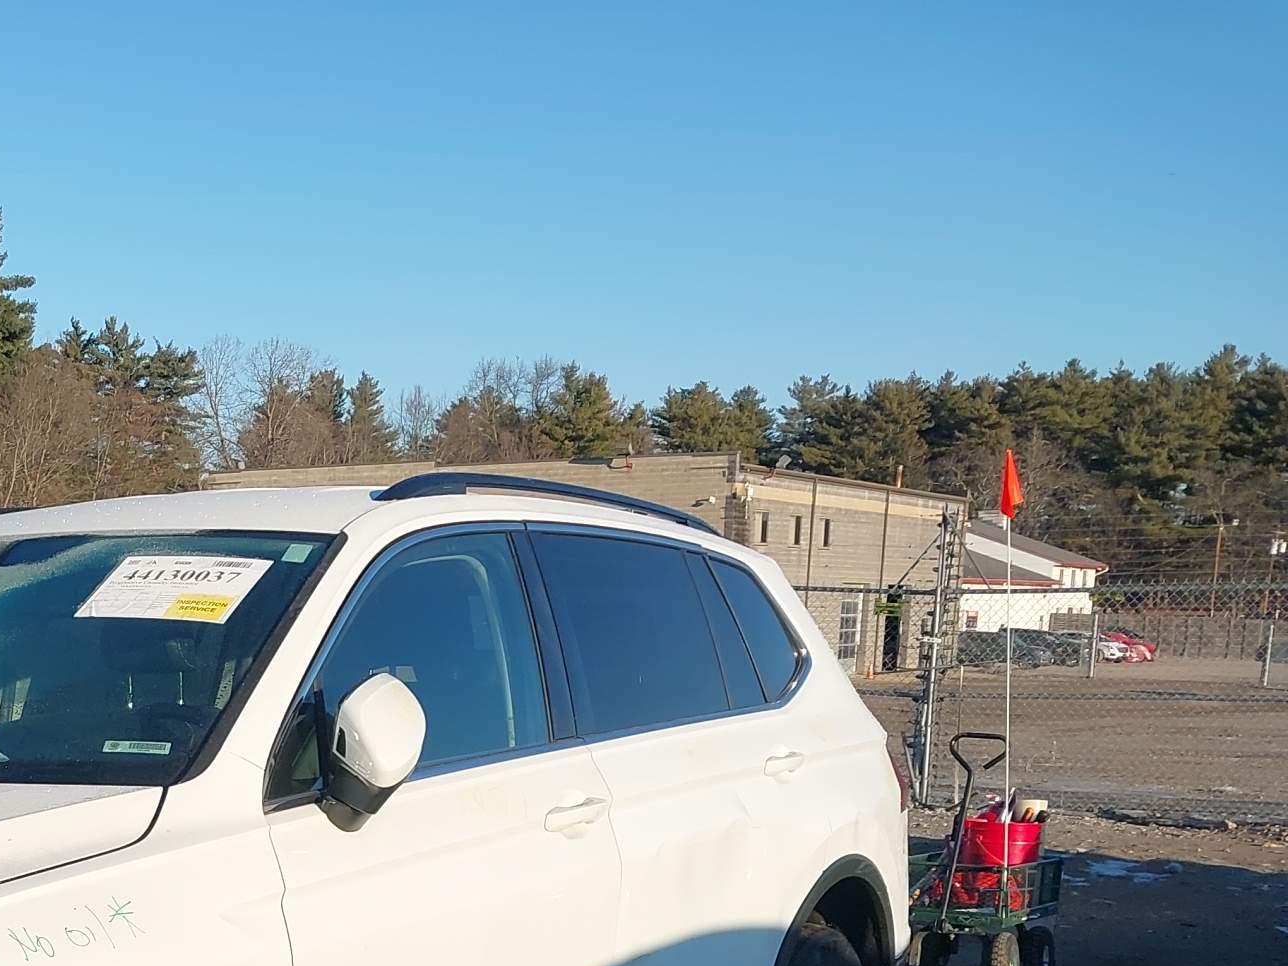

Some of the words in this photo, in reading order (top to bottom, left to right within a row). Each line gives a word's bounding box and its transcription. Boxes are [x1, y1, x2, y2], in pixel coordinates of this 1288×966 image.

[123, 569, 241, 584] 44130037
[176, 599, 229, 609] INSPECTION
[178, 605, 217, 613] SERVICE
[7, 927, 55, 961] No
